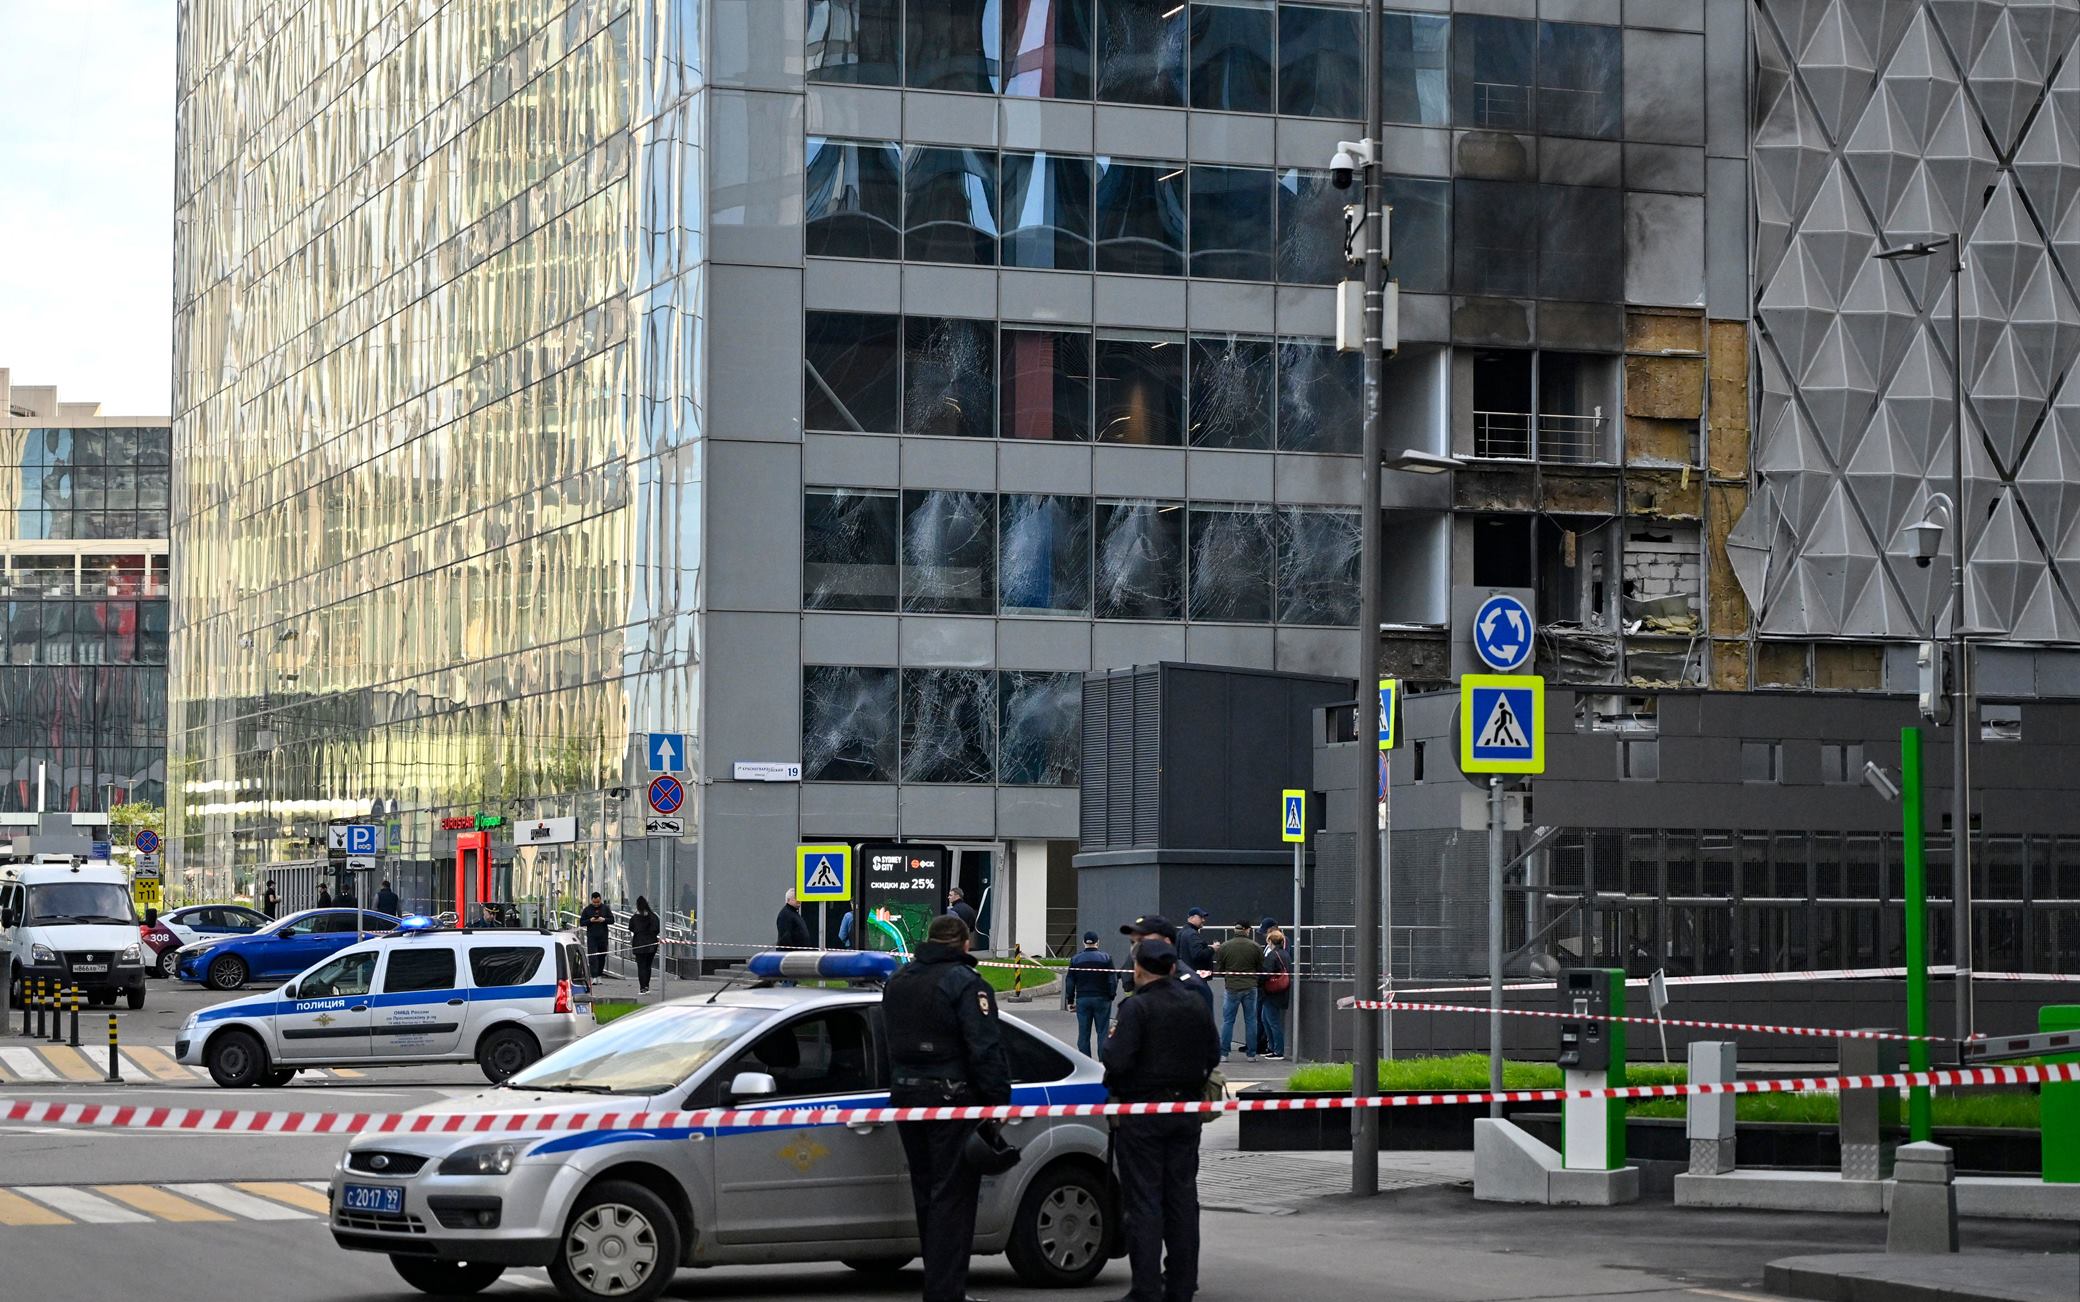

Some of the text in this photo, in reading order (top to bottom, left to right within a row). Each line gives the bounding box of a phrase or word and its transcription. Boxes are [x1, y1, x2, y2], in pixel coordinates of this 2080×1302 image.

[788, 767, 798, 777] 19
[353, 827, 369, 850] P
[870, 878, 935, 890] скидки до 25%
[150, 933, 170, 942] 308
[296, 999, 345, 1011] ПОЛИЦИЯ
[355, 1188, 381, 1208] 2017
[387, 1189, 398, 1204] 99
